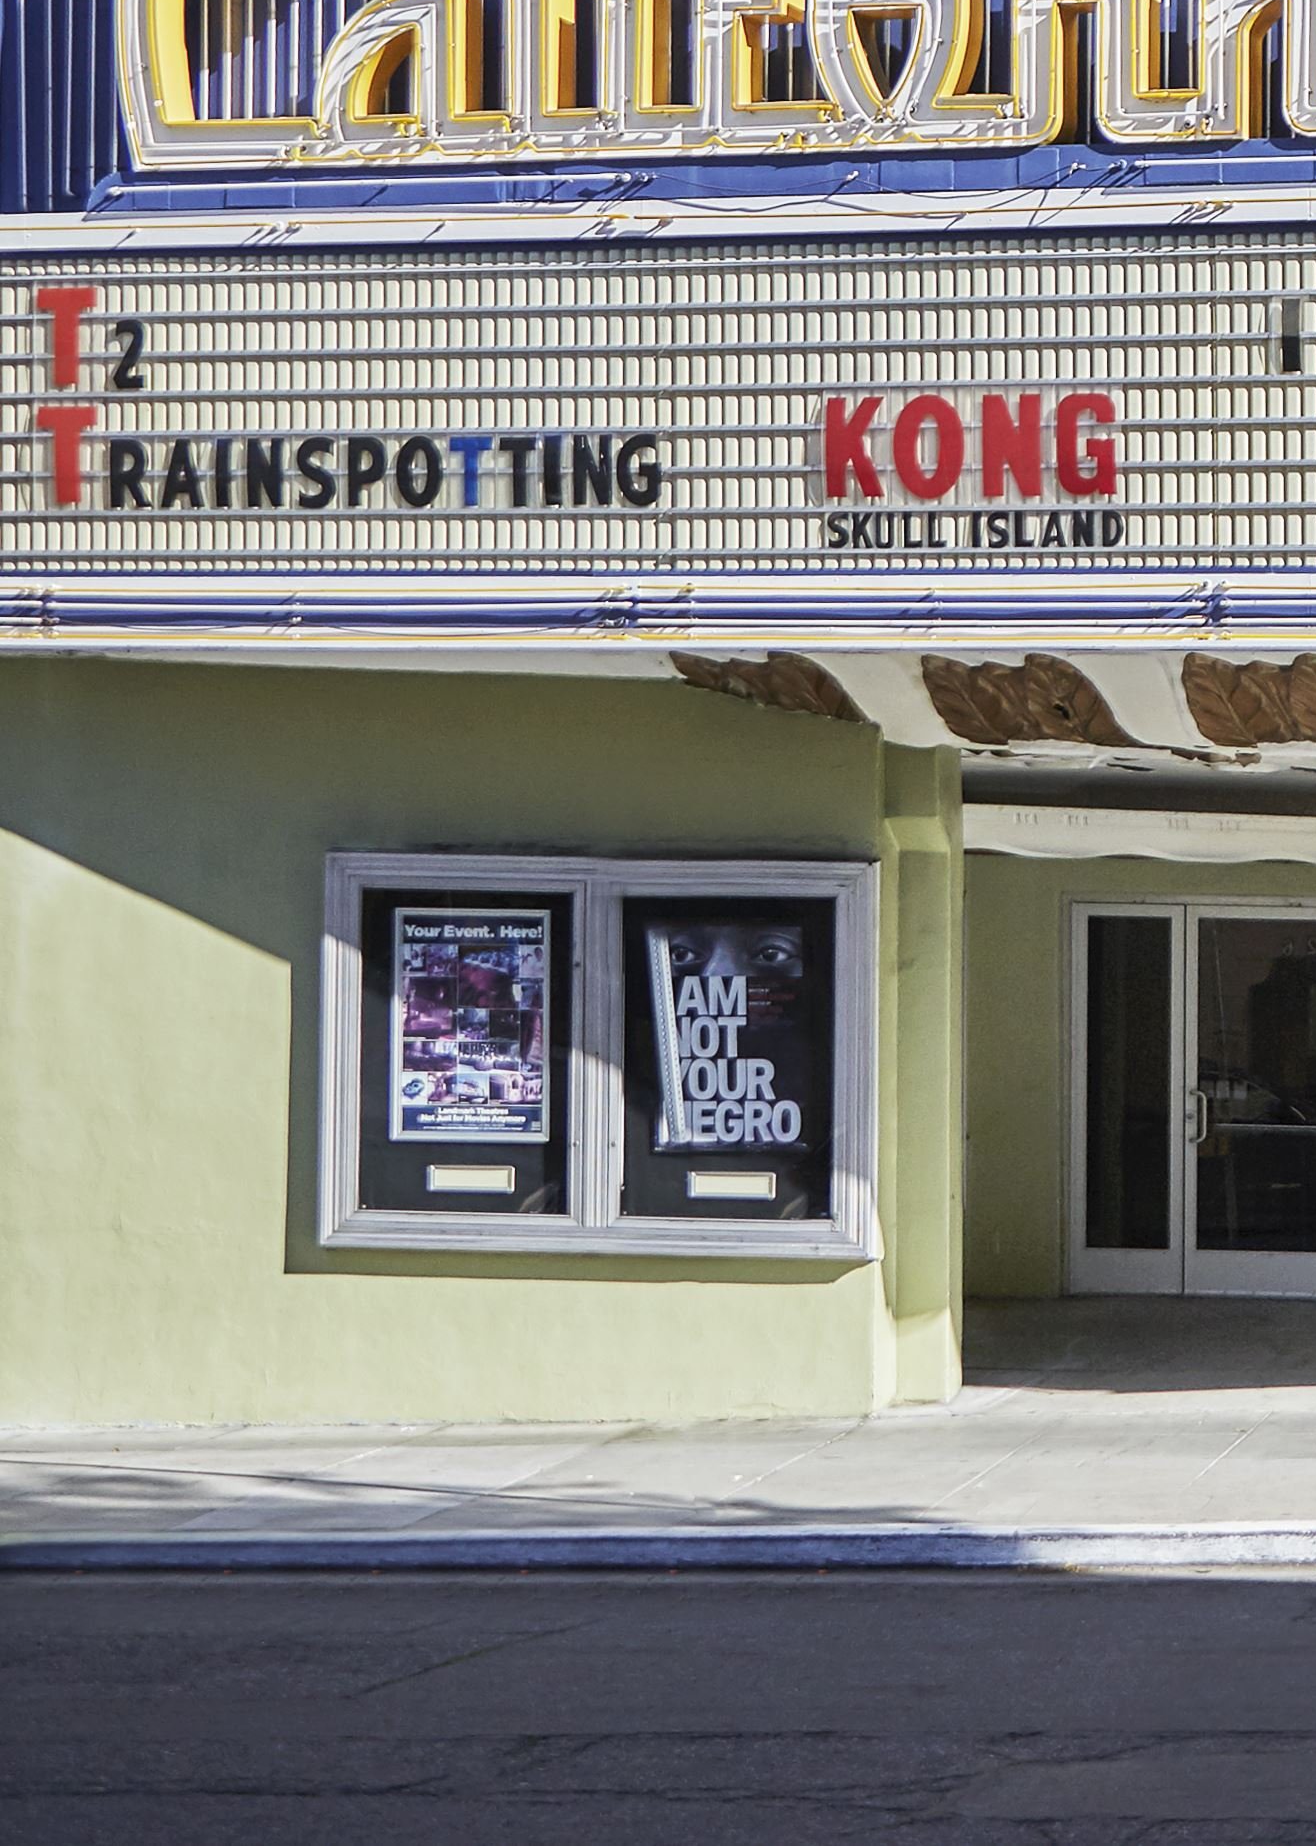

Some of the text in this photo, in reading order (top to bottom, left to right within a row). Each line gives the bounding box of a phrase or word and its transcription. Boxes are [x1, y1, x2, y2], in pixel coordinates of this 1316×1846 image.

[37, 287, 147, 390] T 2
[1281, 297, 1301, 371] I
[37, 406, 663, 509] TRAINSPOTTING
[825, 392, 1117, 499] KONG
[826, 509, 1124, 550] SKULL ISLAND
[404, 924, 543, 938] Your Event. Here!
[677, 975, 747, 1016] AM
